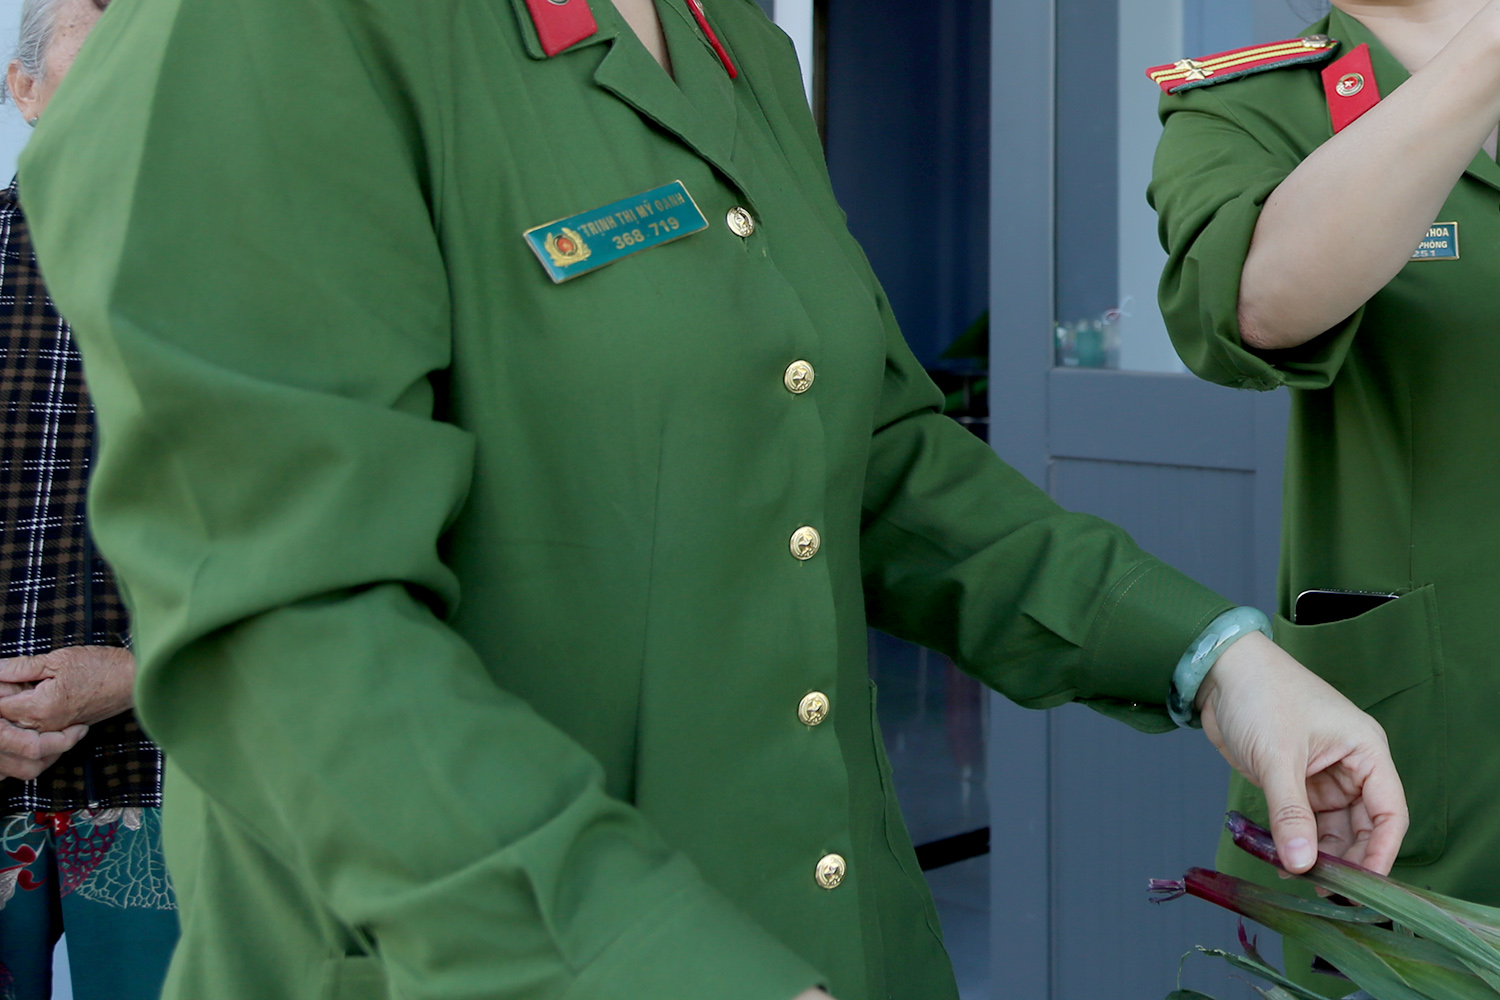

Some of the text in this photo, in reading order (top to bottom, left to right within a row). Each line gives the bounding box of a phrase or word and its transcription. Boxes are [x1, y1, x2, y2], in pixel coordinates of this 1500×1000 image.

[580, 191, 686, 237] TRỊNH THỊ MỸ OANH
